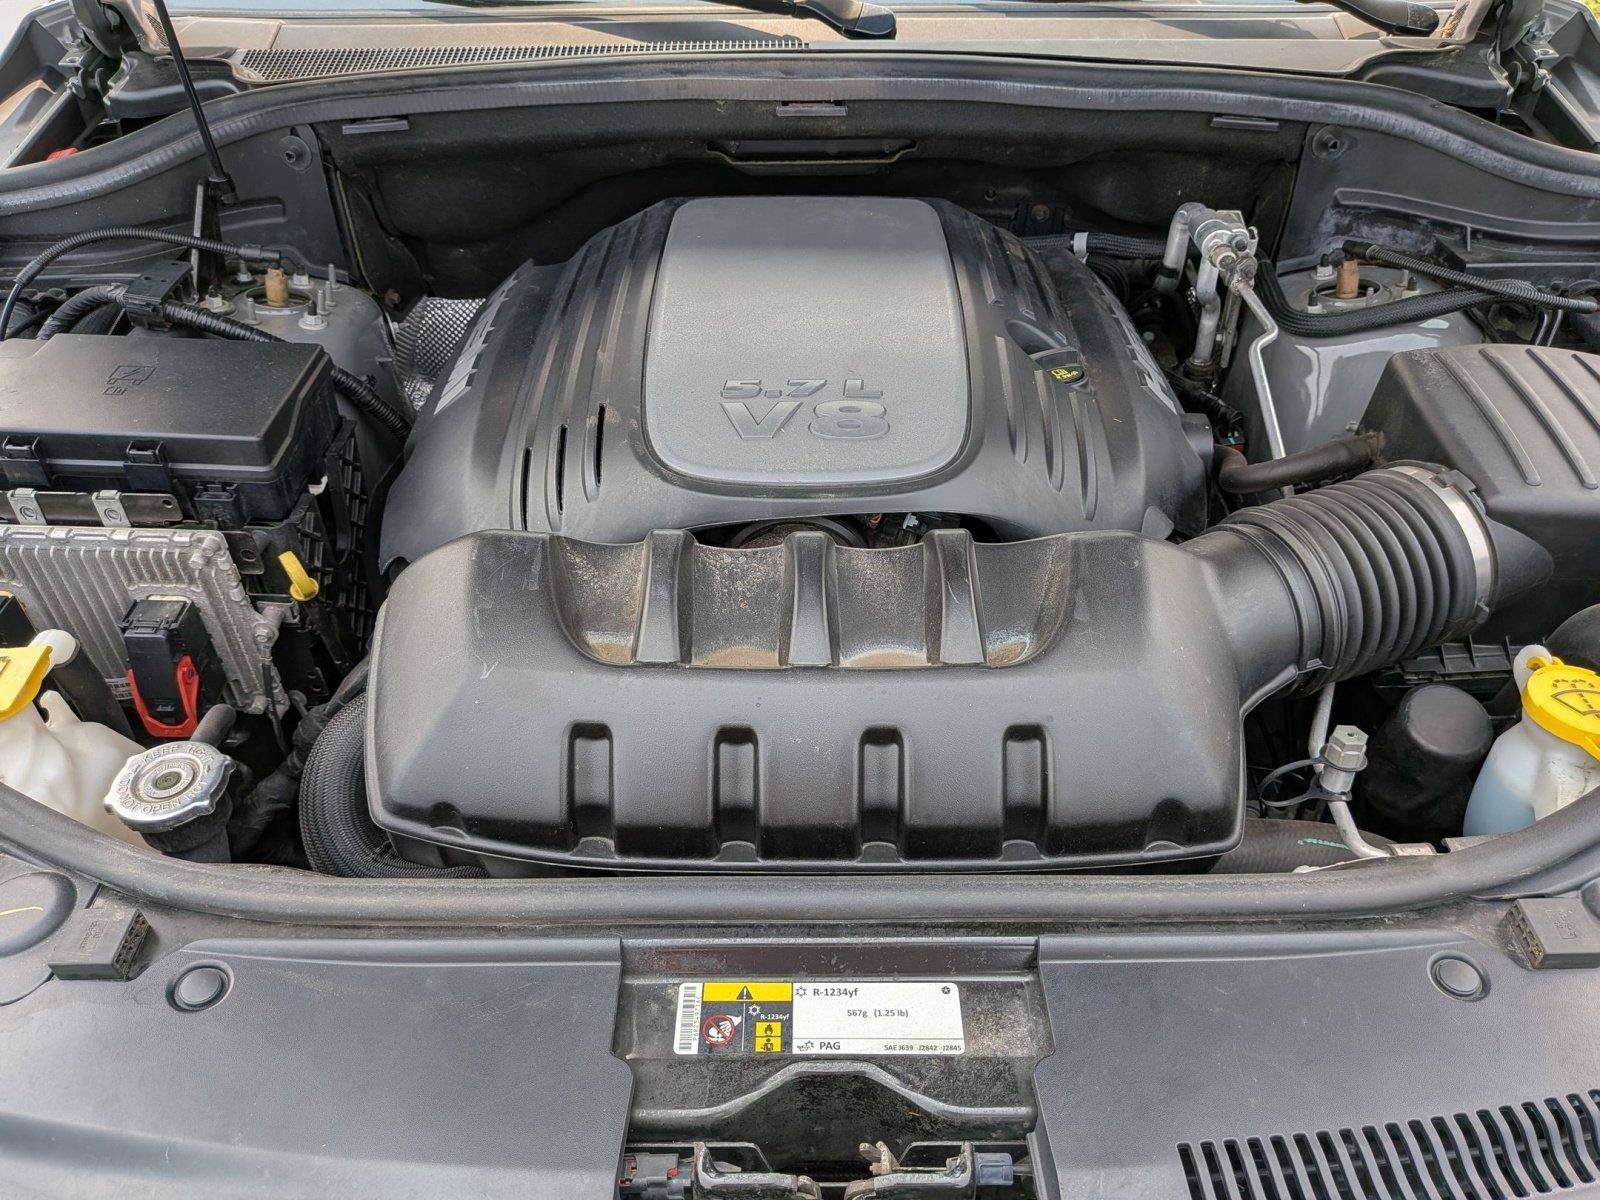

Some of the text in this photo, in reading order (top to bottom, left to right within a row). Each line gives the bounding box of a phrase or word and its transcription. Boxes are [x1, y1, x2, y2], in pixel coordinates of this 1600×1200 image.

[720, 401, 890, 441] V8
[142, 743, 181, 764] KEEP
[141, 798, 182, 816] OPEN
[183, 780, 209, 801] HOT
[813, 987, 859, 998] R-1234yf
[760, 1013, 789, 1021] R-1234yf
[847, 1009, 909, 1018] 567g (1.25 lb)
[819, 1042, 841, 1050] PAG
